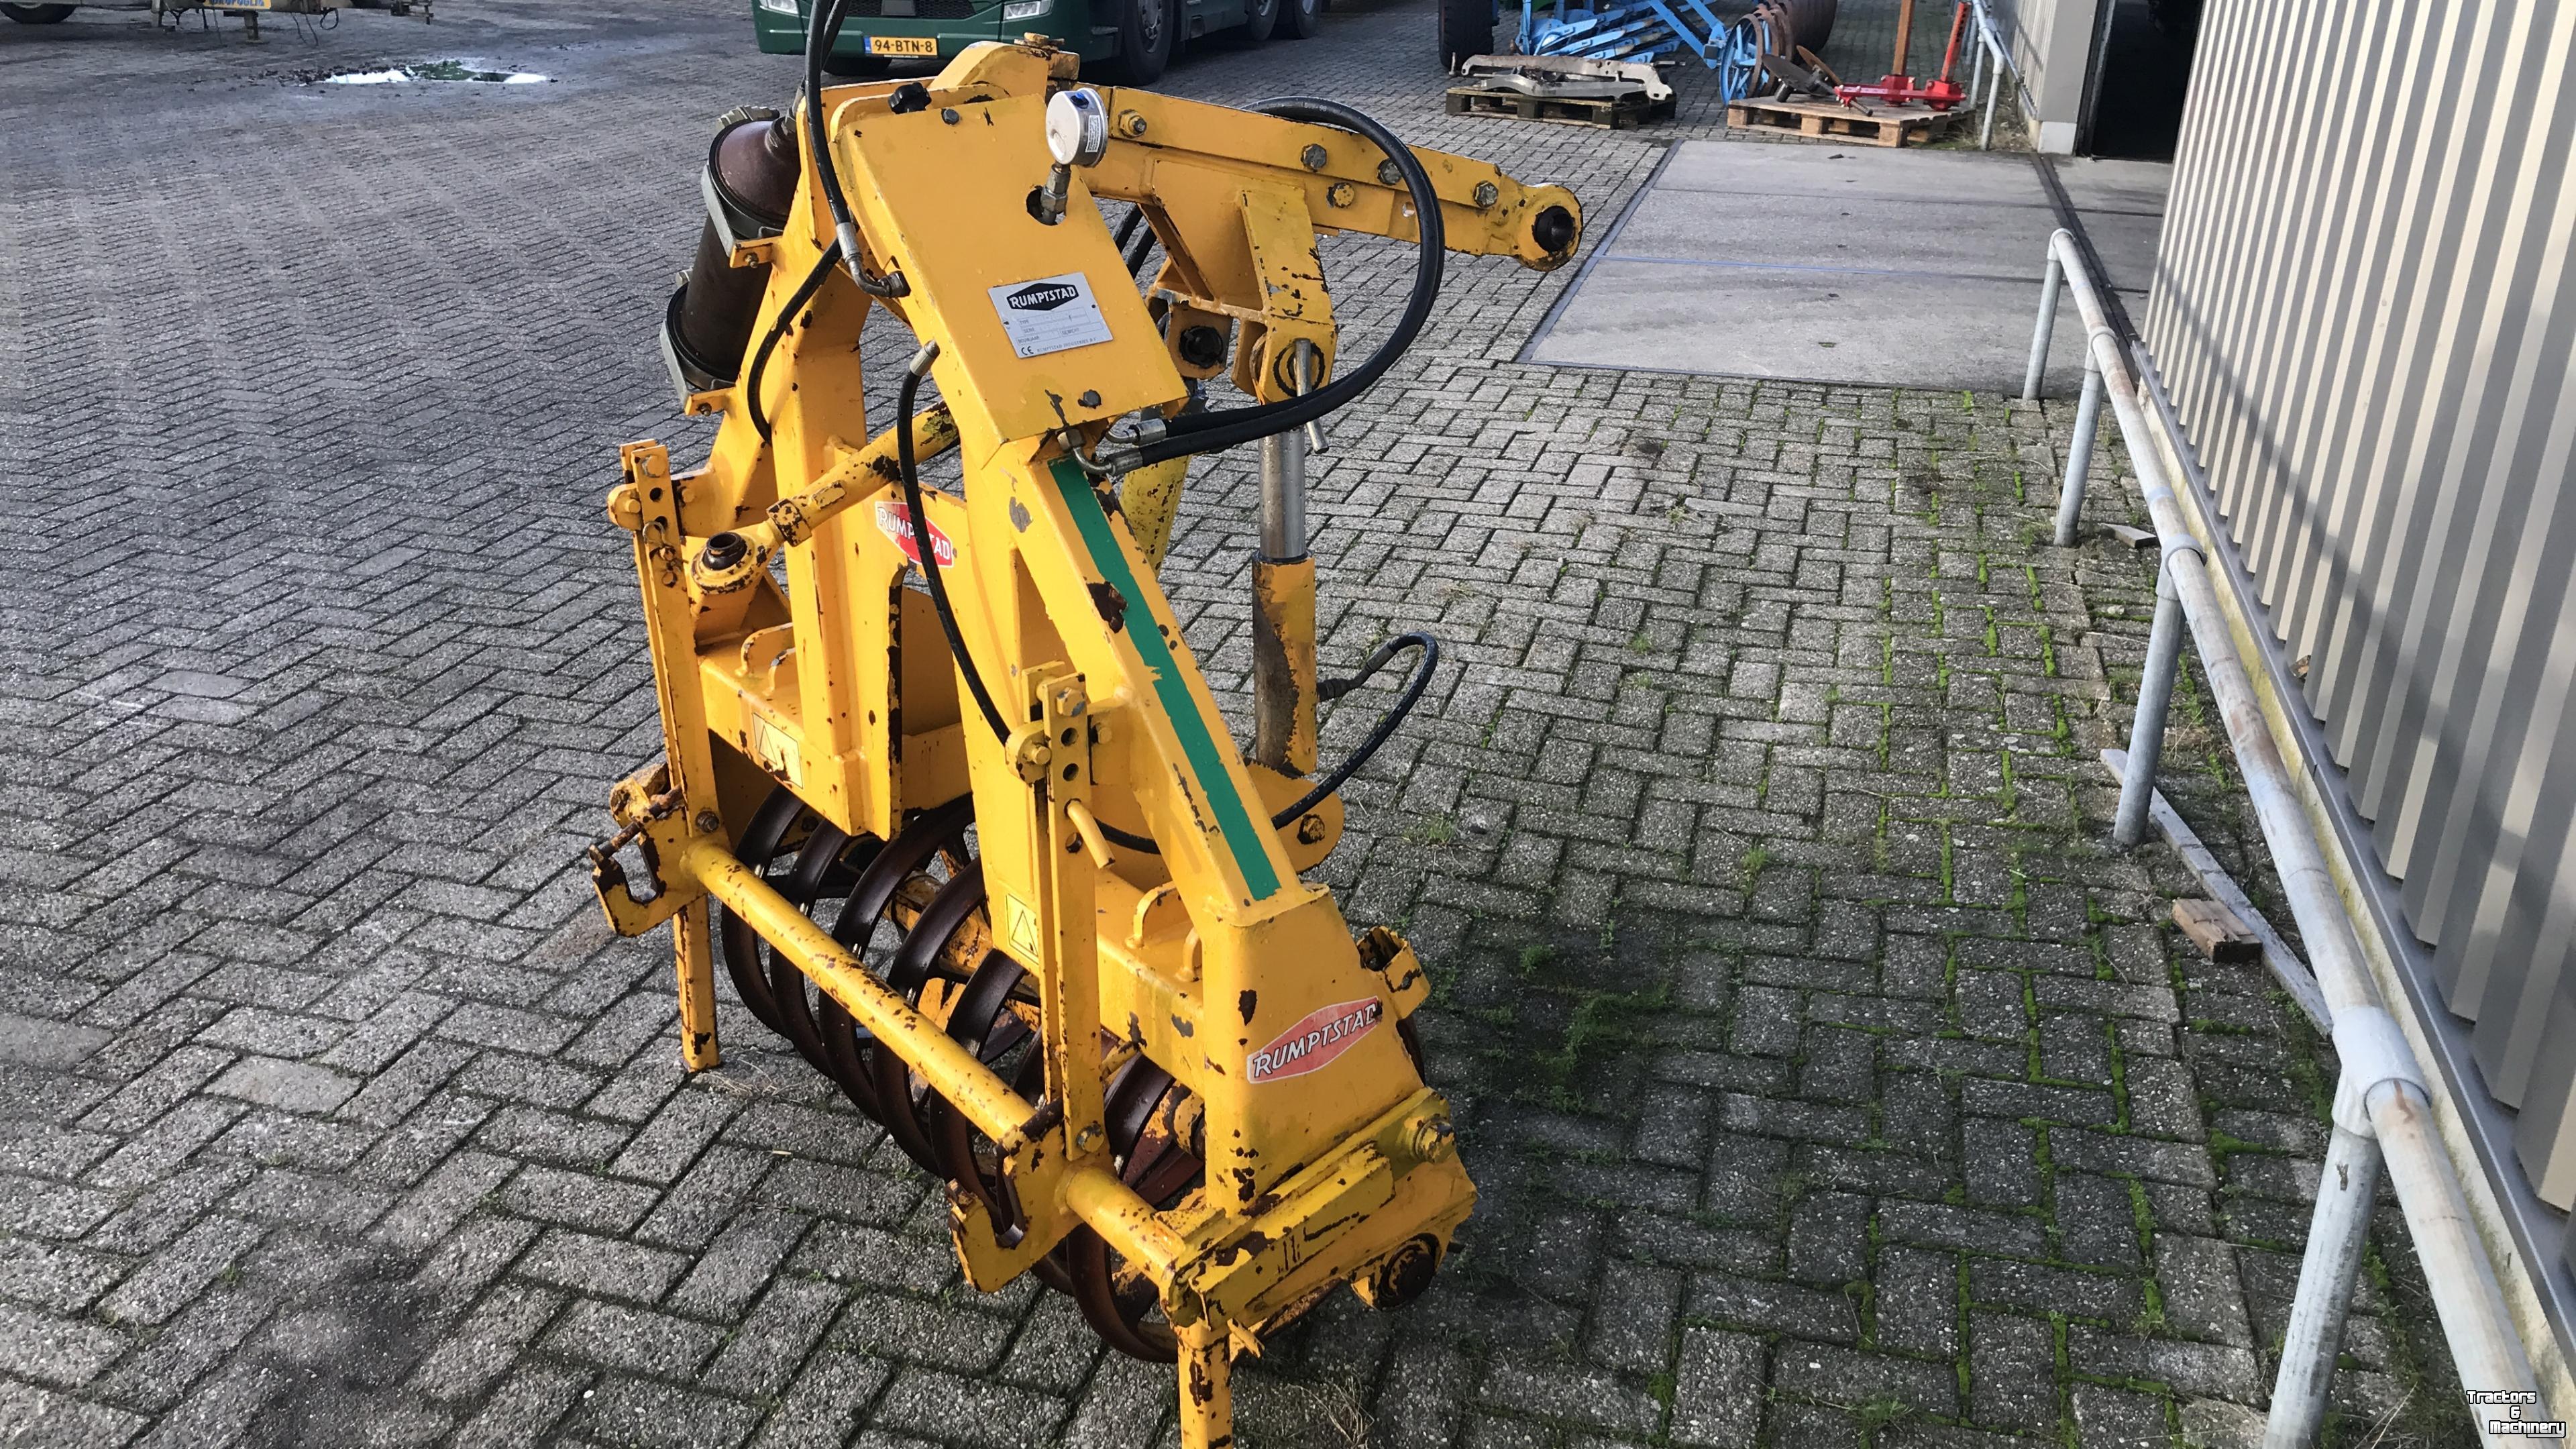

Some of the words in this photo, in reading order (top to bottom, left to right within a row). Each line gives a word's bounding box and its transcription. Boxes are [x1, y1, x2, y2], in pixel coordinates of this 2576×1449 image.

[874, 40, 933, 52] 94-BTN-8
[1008, 286, 1077, 309] RUMPTSTAD
[1252, 1003, 1377, 1078] RUMPTSTAD
